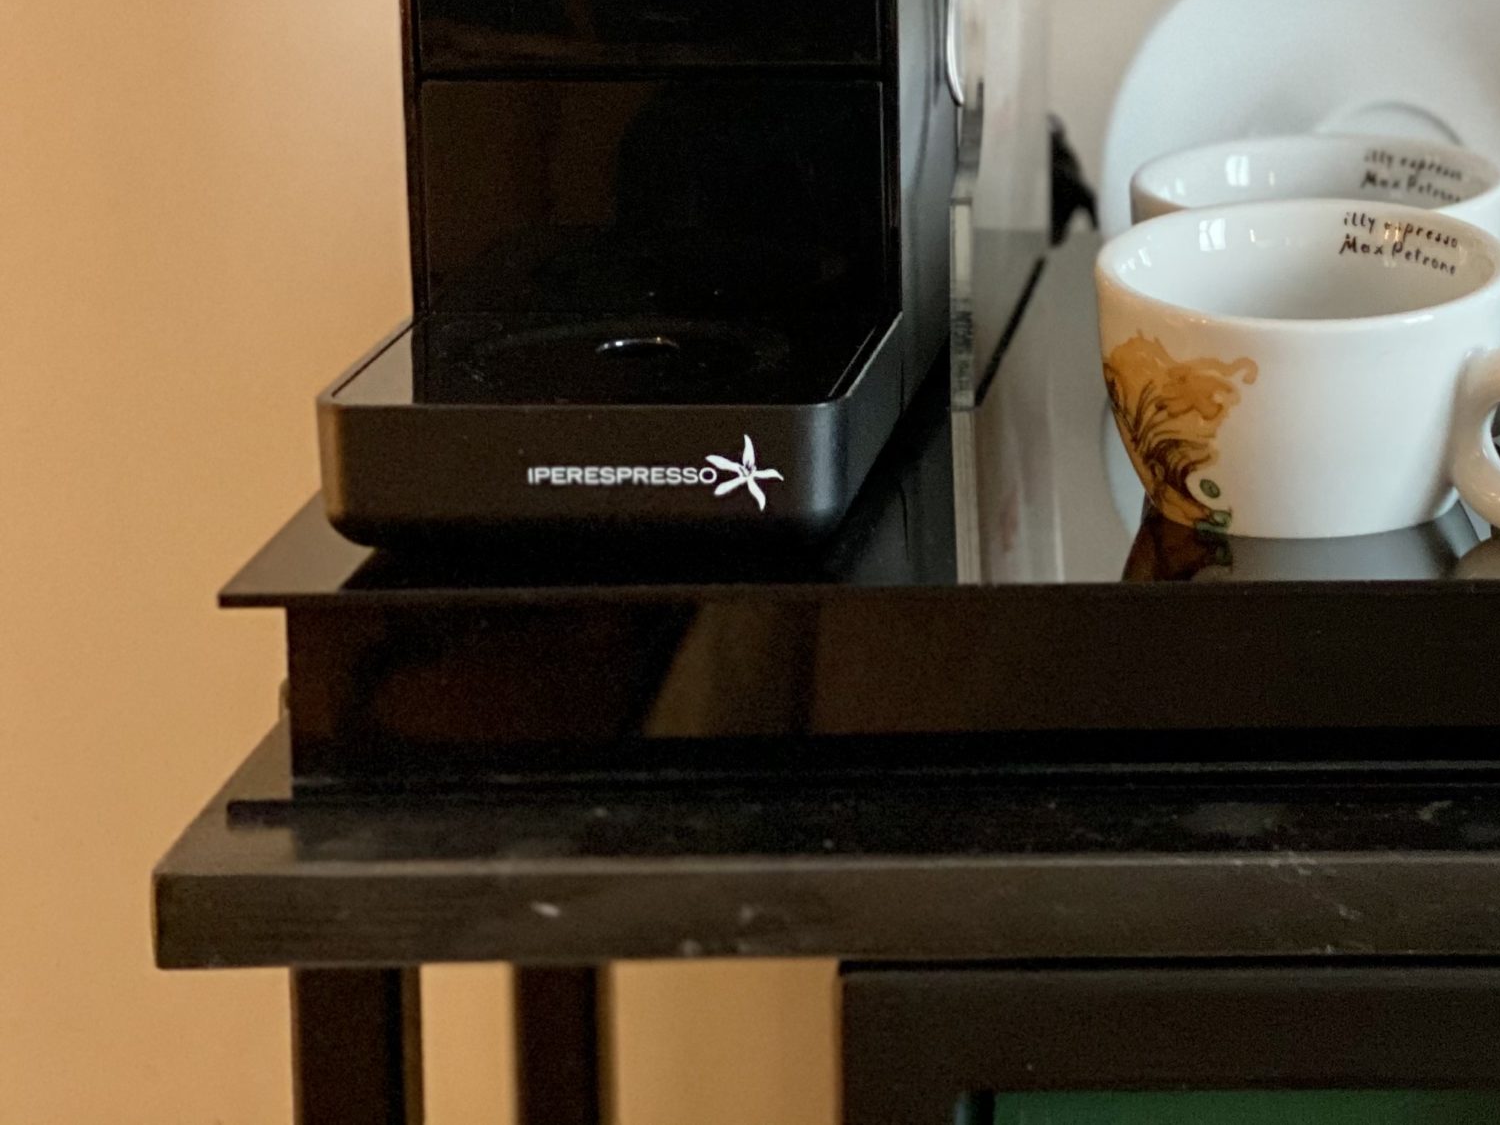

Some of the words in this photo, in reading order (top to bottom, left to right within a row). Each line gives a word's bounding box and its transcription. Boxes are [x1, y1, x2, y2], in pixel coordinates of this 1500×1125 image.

[1364, 149, 1393, 168] illy
[1360, 171, 1400, 188] Max
[1343, 212, 1376, 234] illy
[1384, 222, 1459, 249] espresso
[1339, 234, 1384, 255] Max
[1392, 242, 1456, 275] Petrone
[526, 466, 718, 486] IPERESPRESSO
